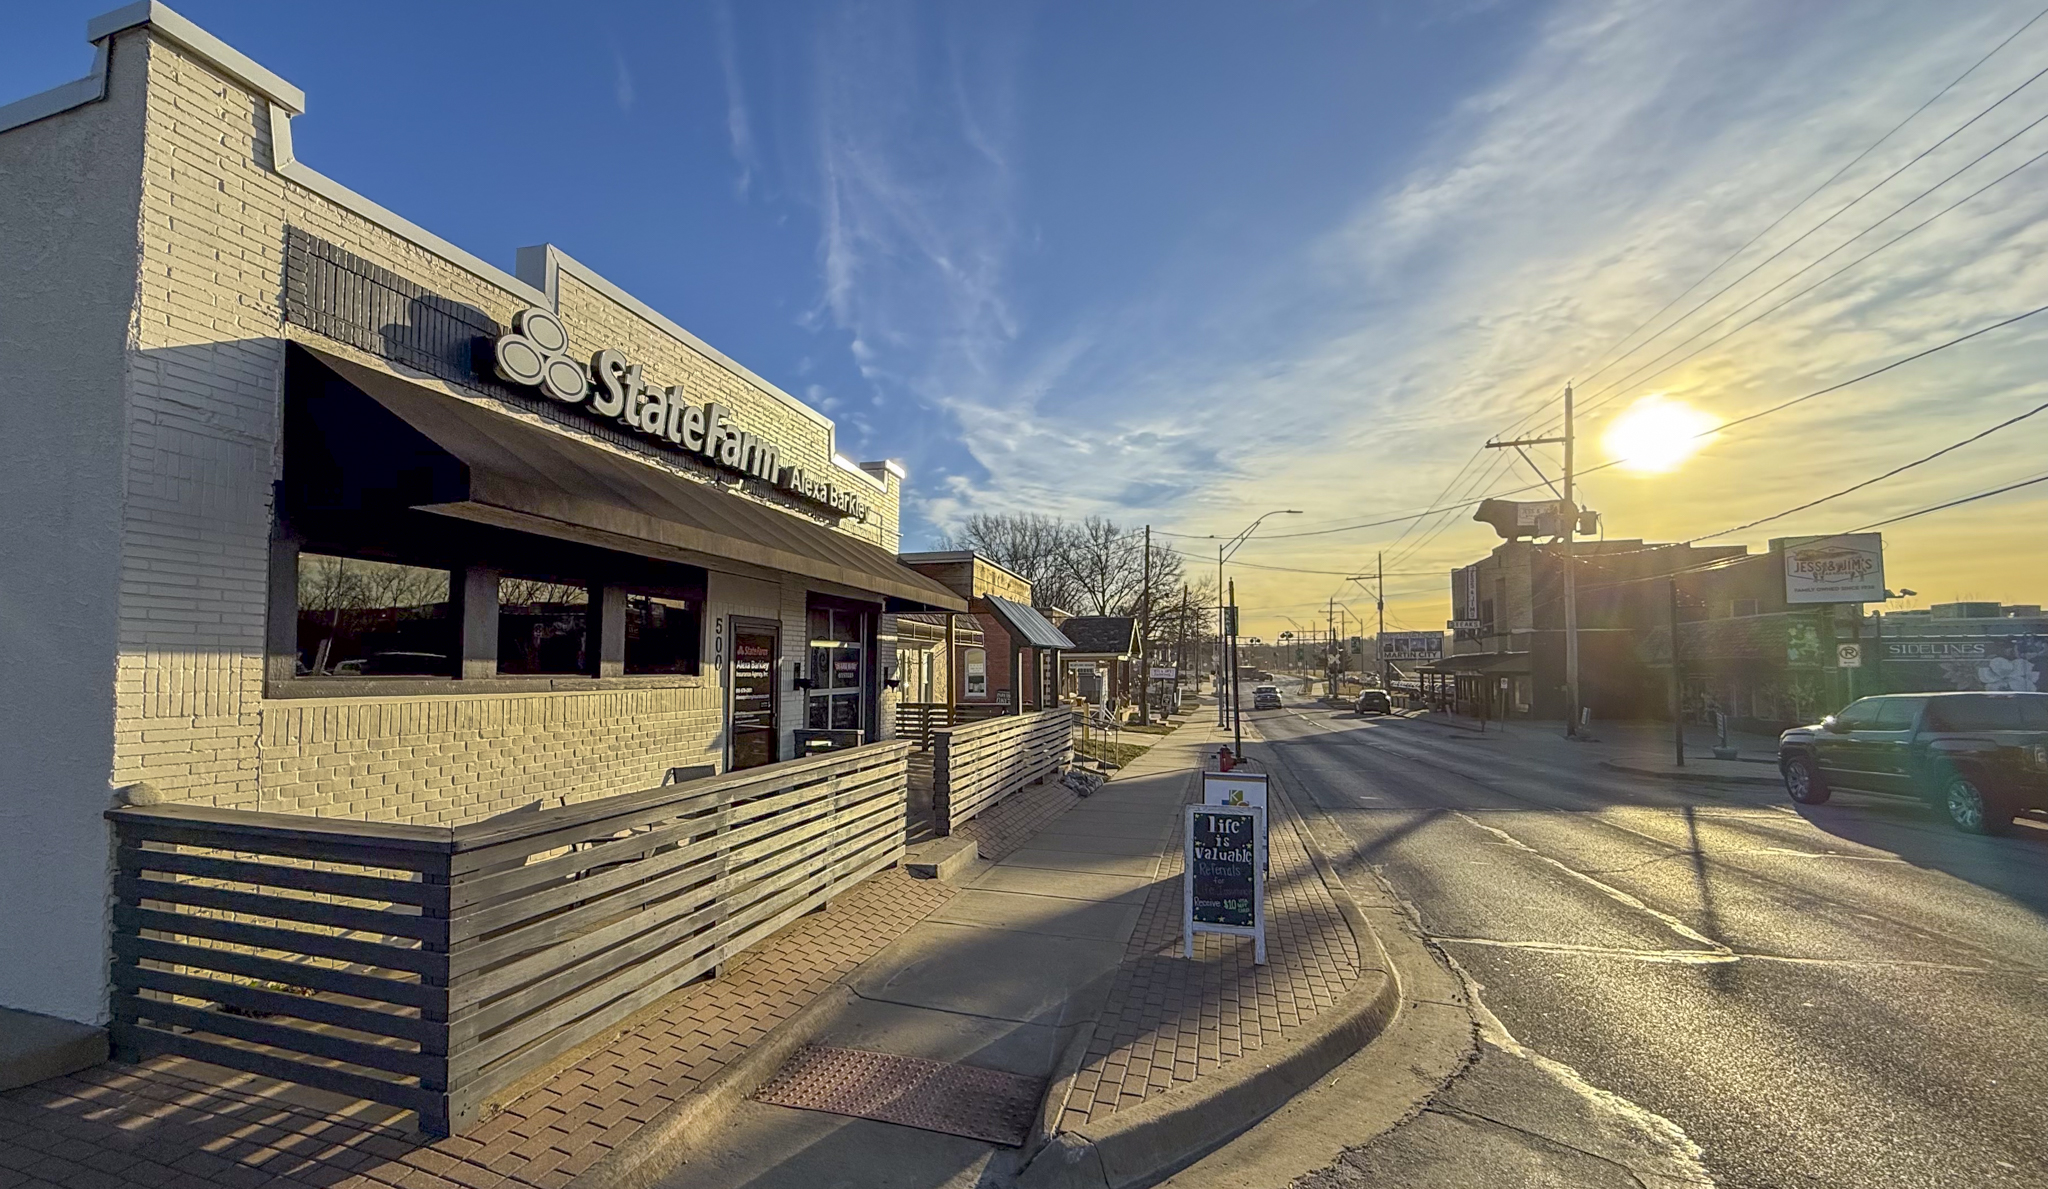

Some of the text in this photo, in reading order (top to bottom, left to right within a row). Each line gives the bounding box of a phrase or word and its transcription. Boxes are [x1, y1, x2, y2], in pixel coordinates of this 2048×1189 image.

[790, 465, 872, 524] Alexa Barkley
[1794, 558, 1873, 573] JESS & JIM'S
[1889, 643, 1986, 655] SIDELINES
[736, 660, 751, 670] Alexa
[1215, 834, 1230, 847] is
[1194, 896, 1237, 910] Receive $10
